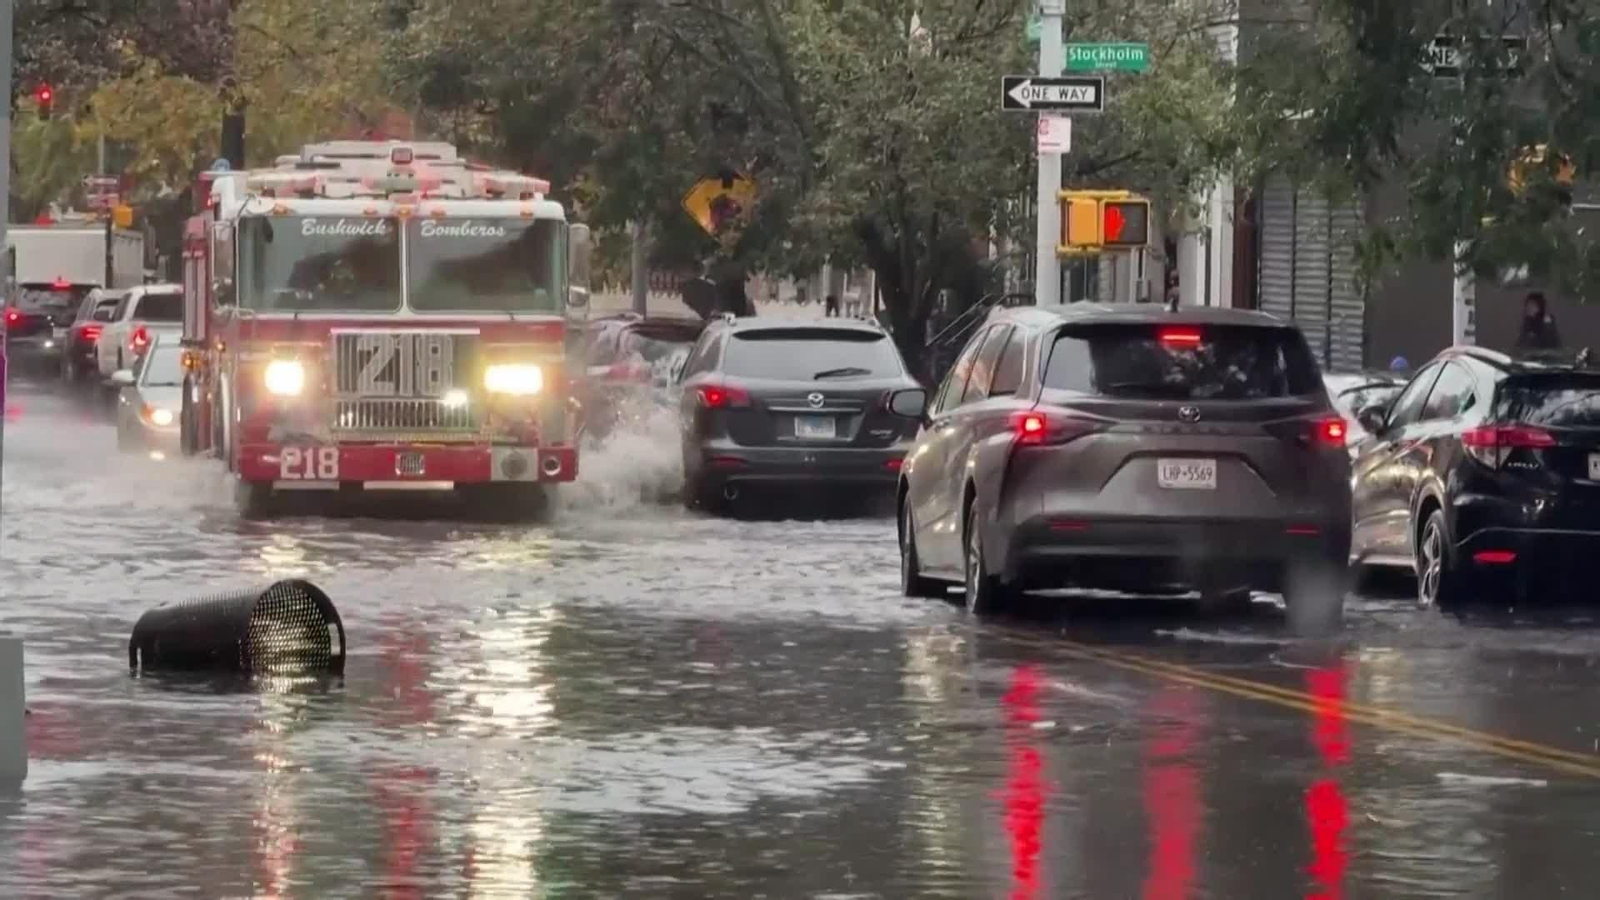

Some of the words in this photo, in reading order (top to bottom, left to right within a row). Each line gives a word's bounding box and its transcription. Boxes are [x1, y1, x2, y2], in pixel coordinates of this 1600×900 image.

[1068, 46, 1144, 61] Stockholm
[1020, 87, 1051, 101] ONE
[1058, 87, 1089, 101] WAY
[301, 217, 388, 236] Bushwick
[420, 219, 507, 237] Bomberos
[357, 334, 454, 396] 218
[280, 447, 340, 479] 218
